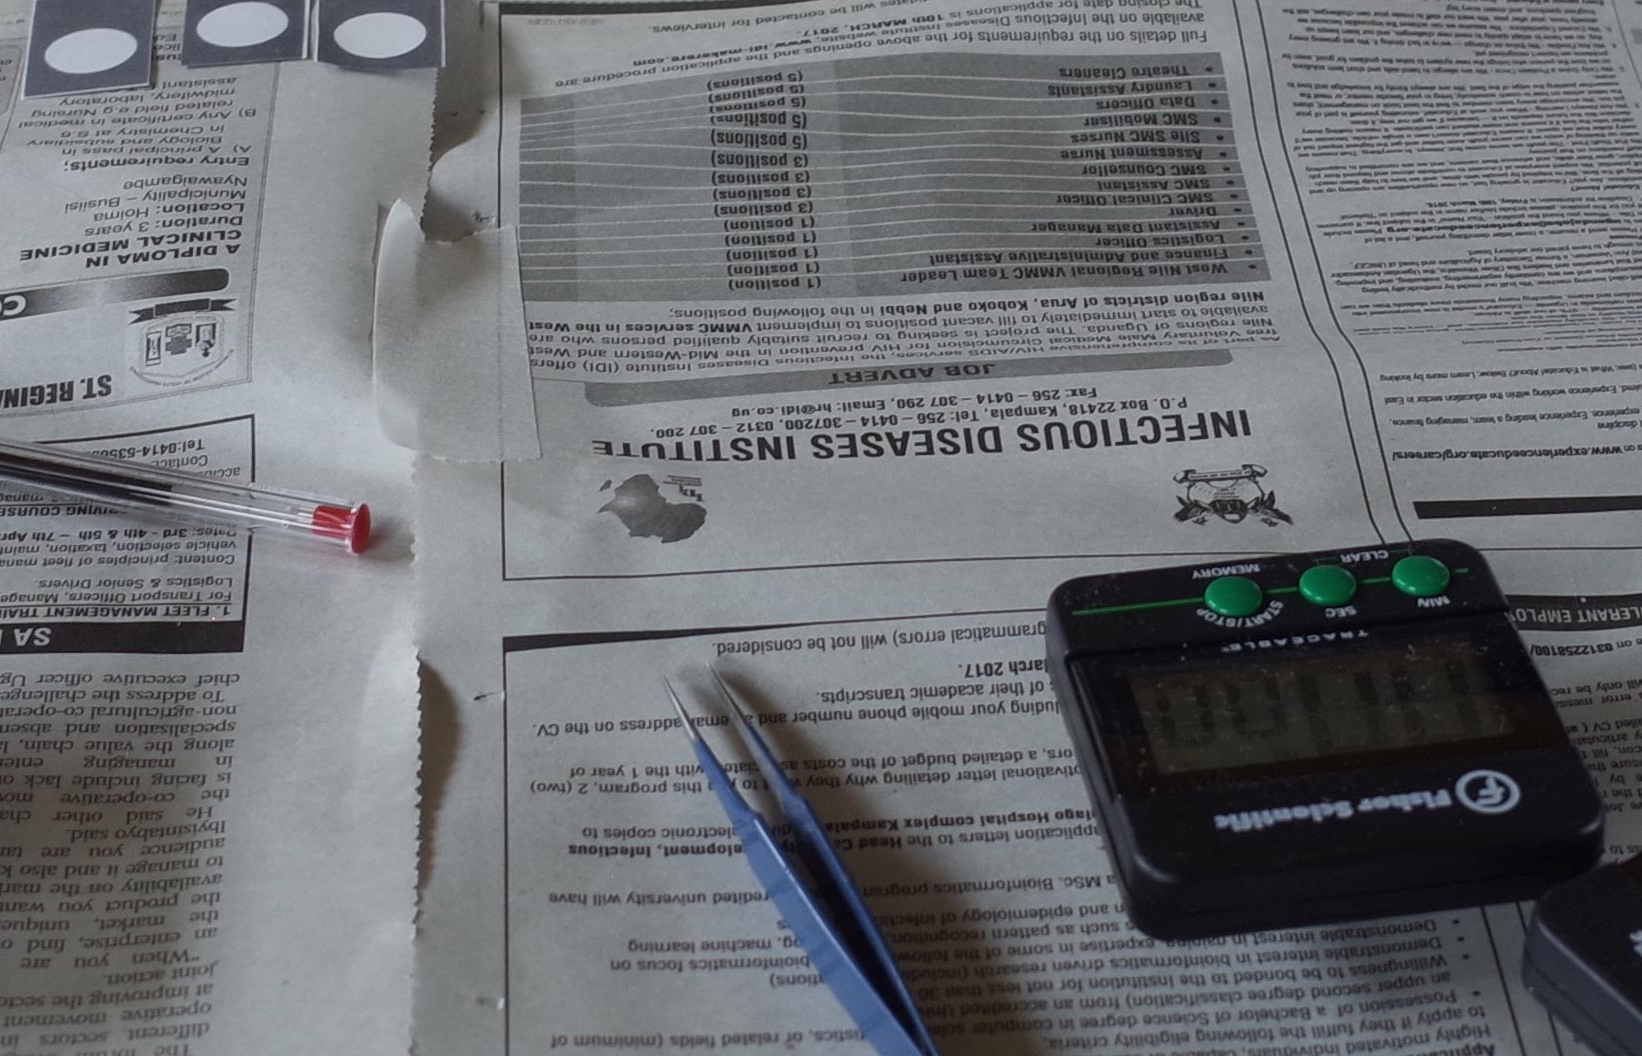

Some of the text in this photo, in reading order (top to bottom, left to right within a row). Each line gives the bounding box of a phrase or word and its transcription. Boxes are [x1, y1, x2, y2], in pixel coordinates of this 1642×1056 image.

[19, 229, 242, 261] CLINICAL MEDICINE
[85, 243, 242, 269] A DIPLOMA IN
[79, 374, 112, 398] ST.
[828, 362, 996, 386] JOB ADVERT
[591, 408, 1252, 462] INFECTIOUS DISEASES INSTITUTE
[1339, 549, 1389, 564] CLEAR
[1191, 563, 1260, 579] MEMORY
[1325, 606, 1357, 618] SEC
[1417, 595, 1451, 608] MIN
[1196, 600, 1284, 628] START/STOP
[13, 626, 52, 647] SA
[1214, 788, 1453, 832] Fisher Scientific
